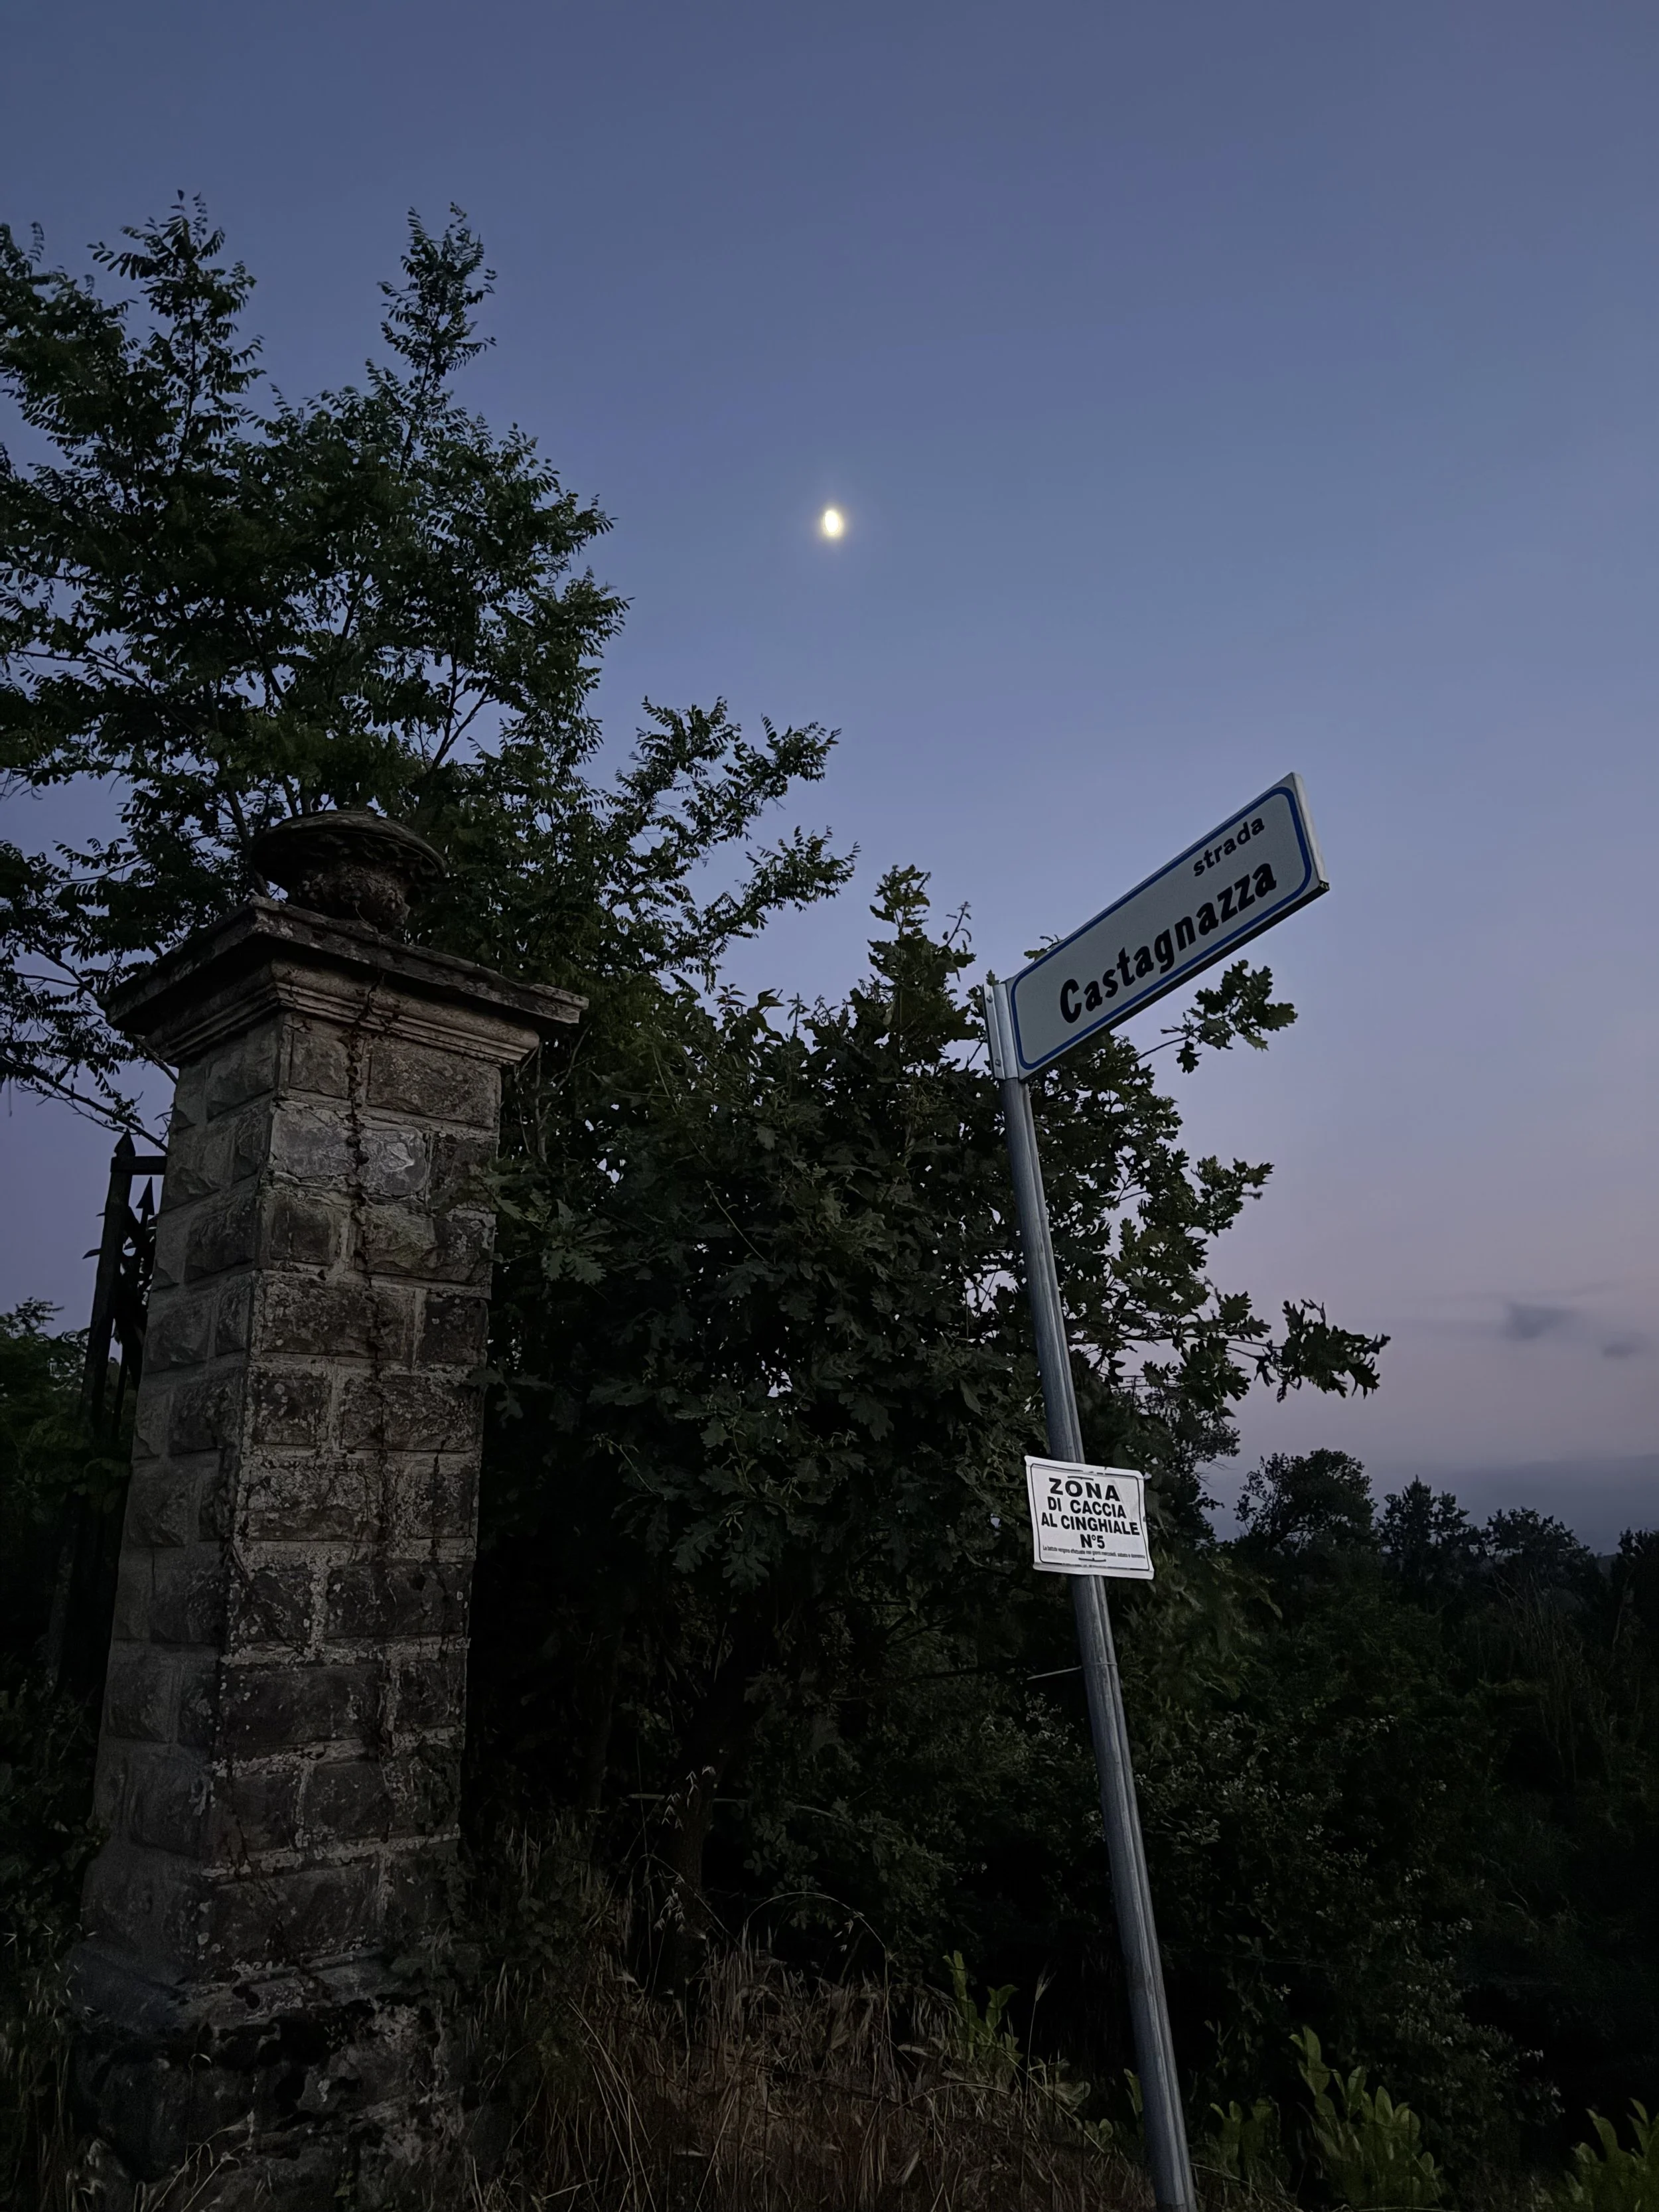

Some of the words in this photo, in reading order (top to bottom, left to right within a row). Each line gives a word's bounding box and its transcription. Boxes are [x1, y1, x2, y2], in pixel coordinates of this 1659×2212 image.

[1193, 816, 1265, 877] strada
[1060, 862, 1277, 1023] Castagnazza
[1048, 1477, 1120, 1502] ZONA
[1047, 1497, 1062, 1512] DI
[1070, 1500, 1126, 1518] CACCIA
[1041, 1512, 1058, 1528] AL
[1061, 1515, 1140, 1536] CINGHIALE
